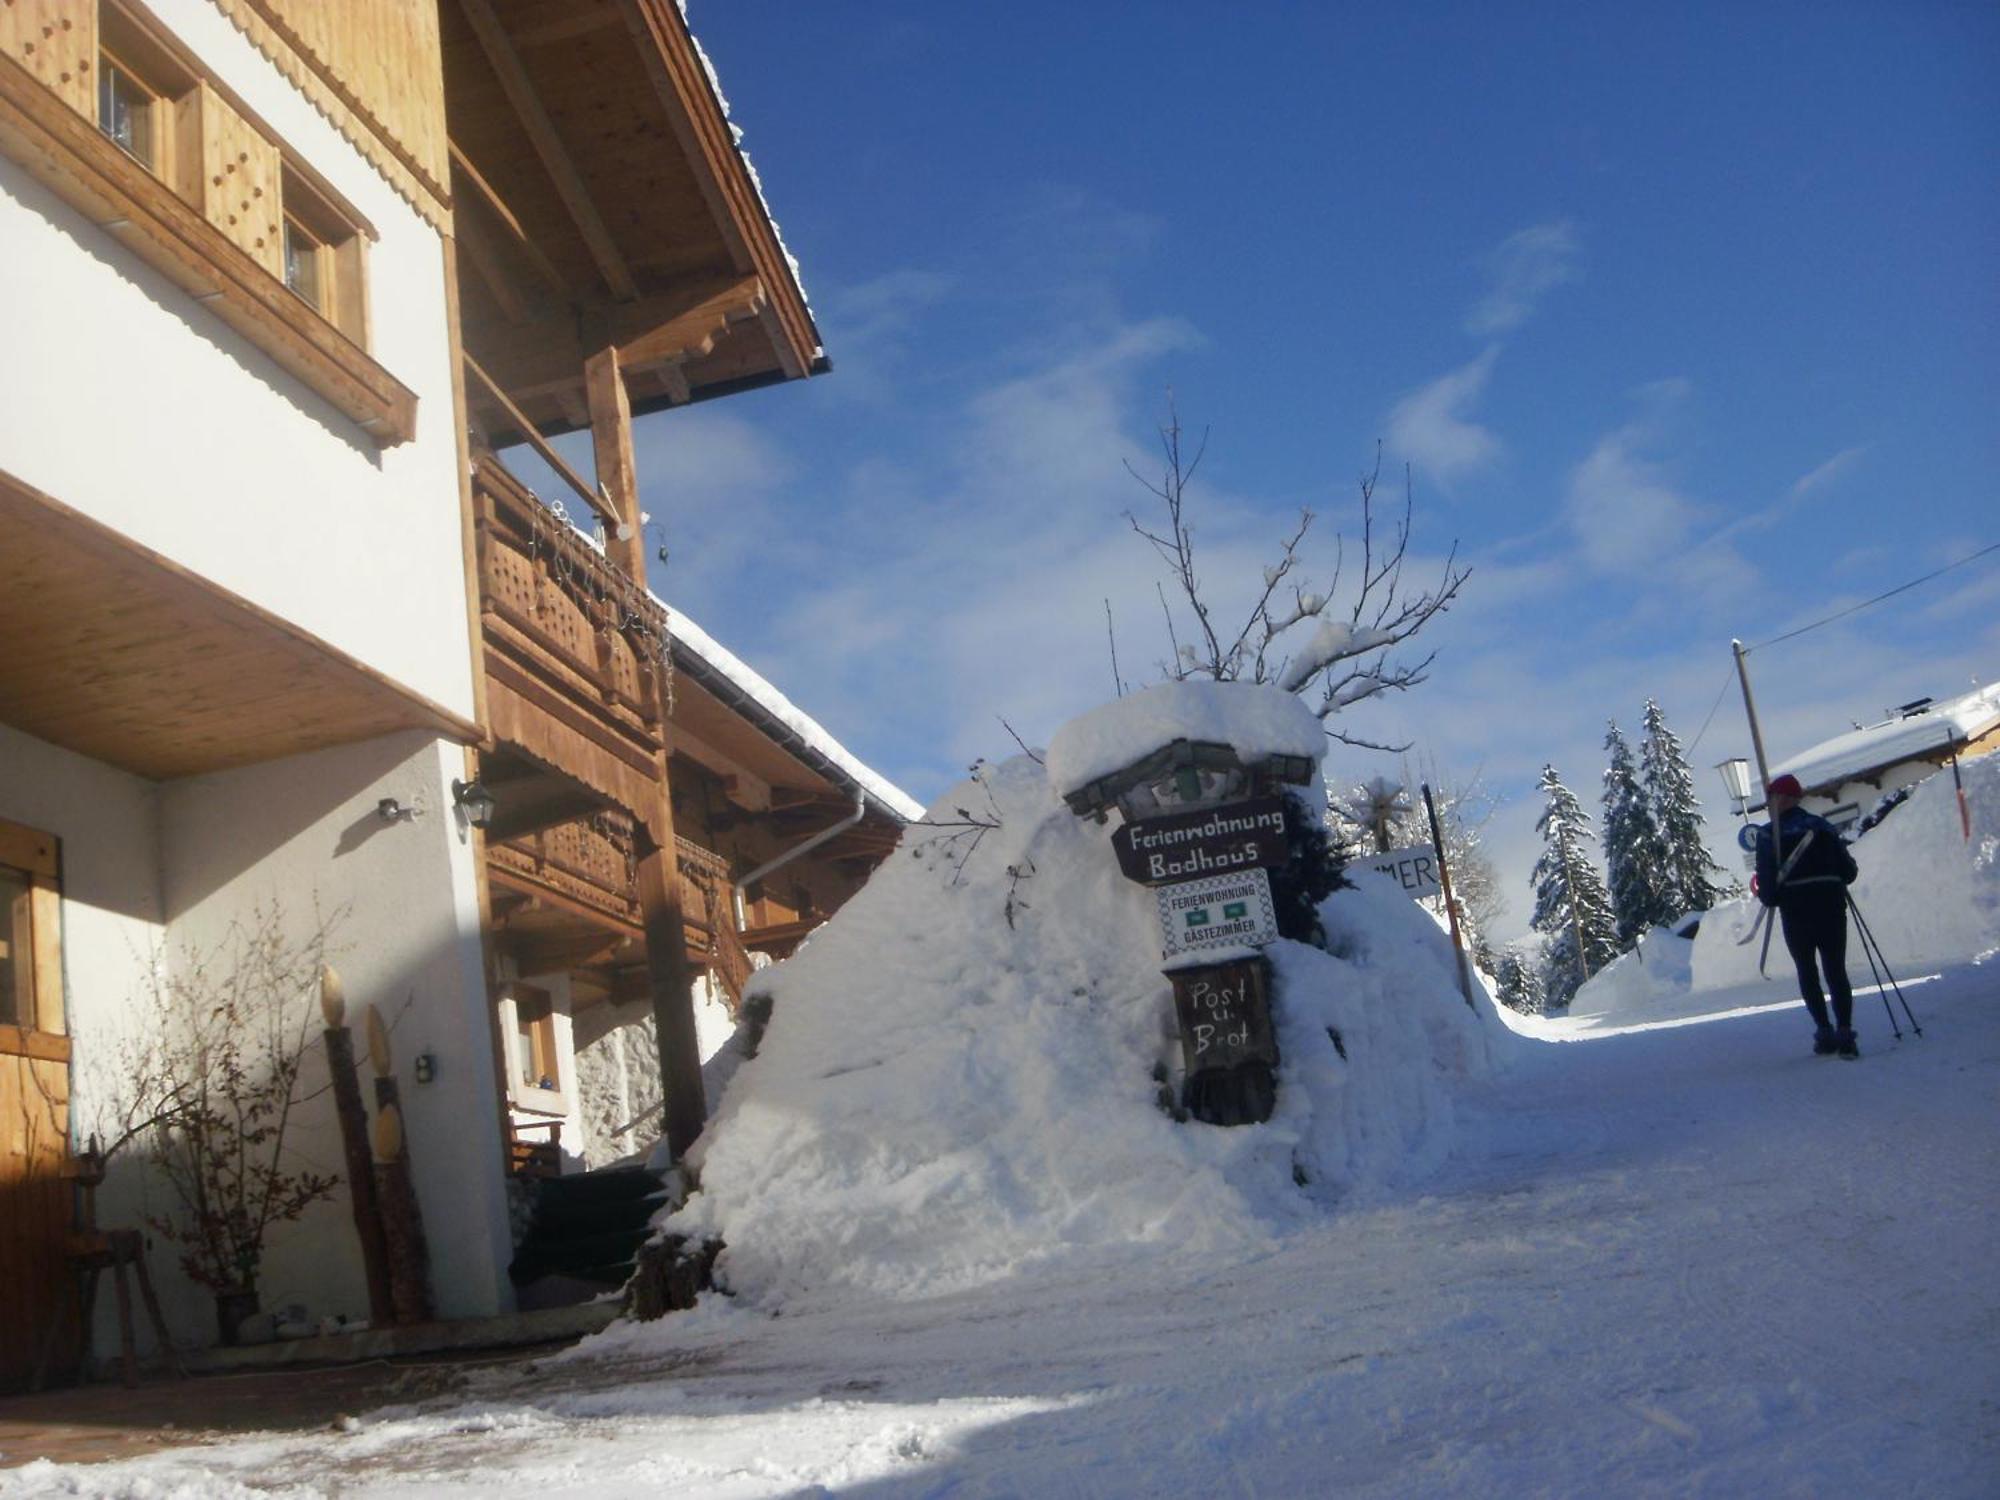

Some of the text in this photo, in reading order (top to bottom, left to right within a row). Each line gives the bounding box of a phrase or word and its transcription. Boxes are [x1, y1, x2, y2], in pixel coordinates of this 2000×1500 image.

[1130, 811, 1286, 851] Ferienwohnung
[1171, 883, 1257, 911] FERIENWOHNUNG
[1183, 919, 1256, 944] GÄSTEZIMMER
[1191, 978, 1246, 1009] Post
[1192, 1020, 1249, 1056] Brot
